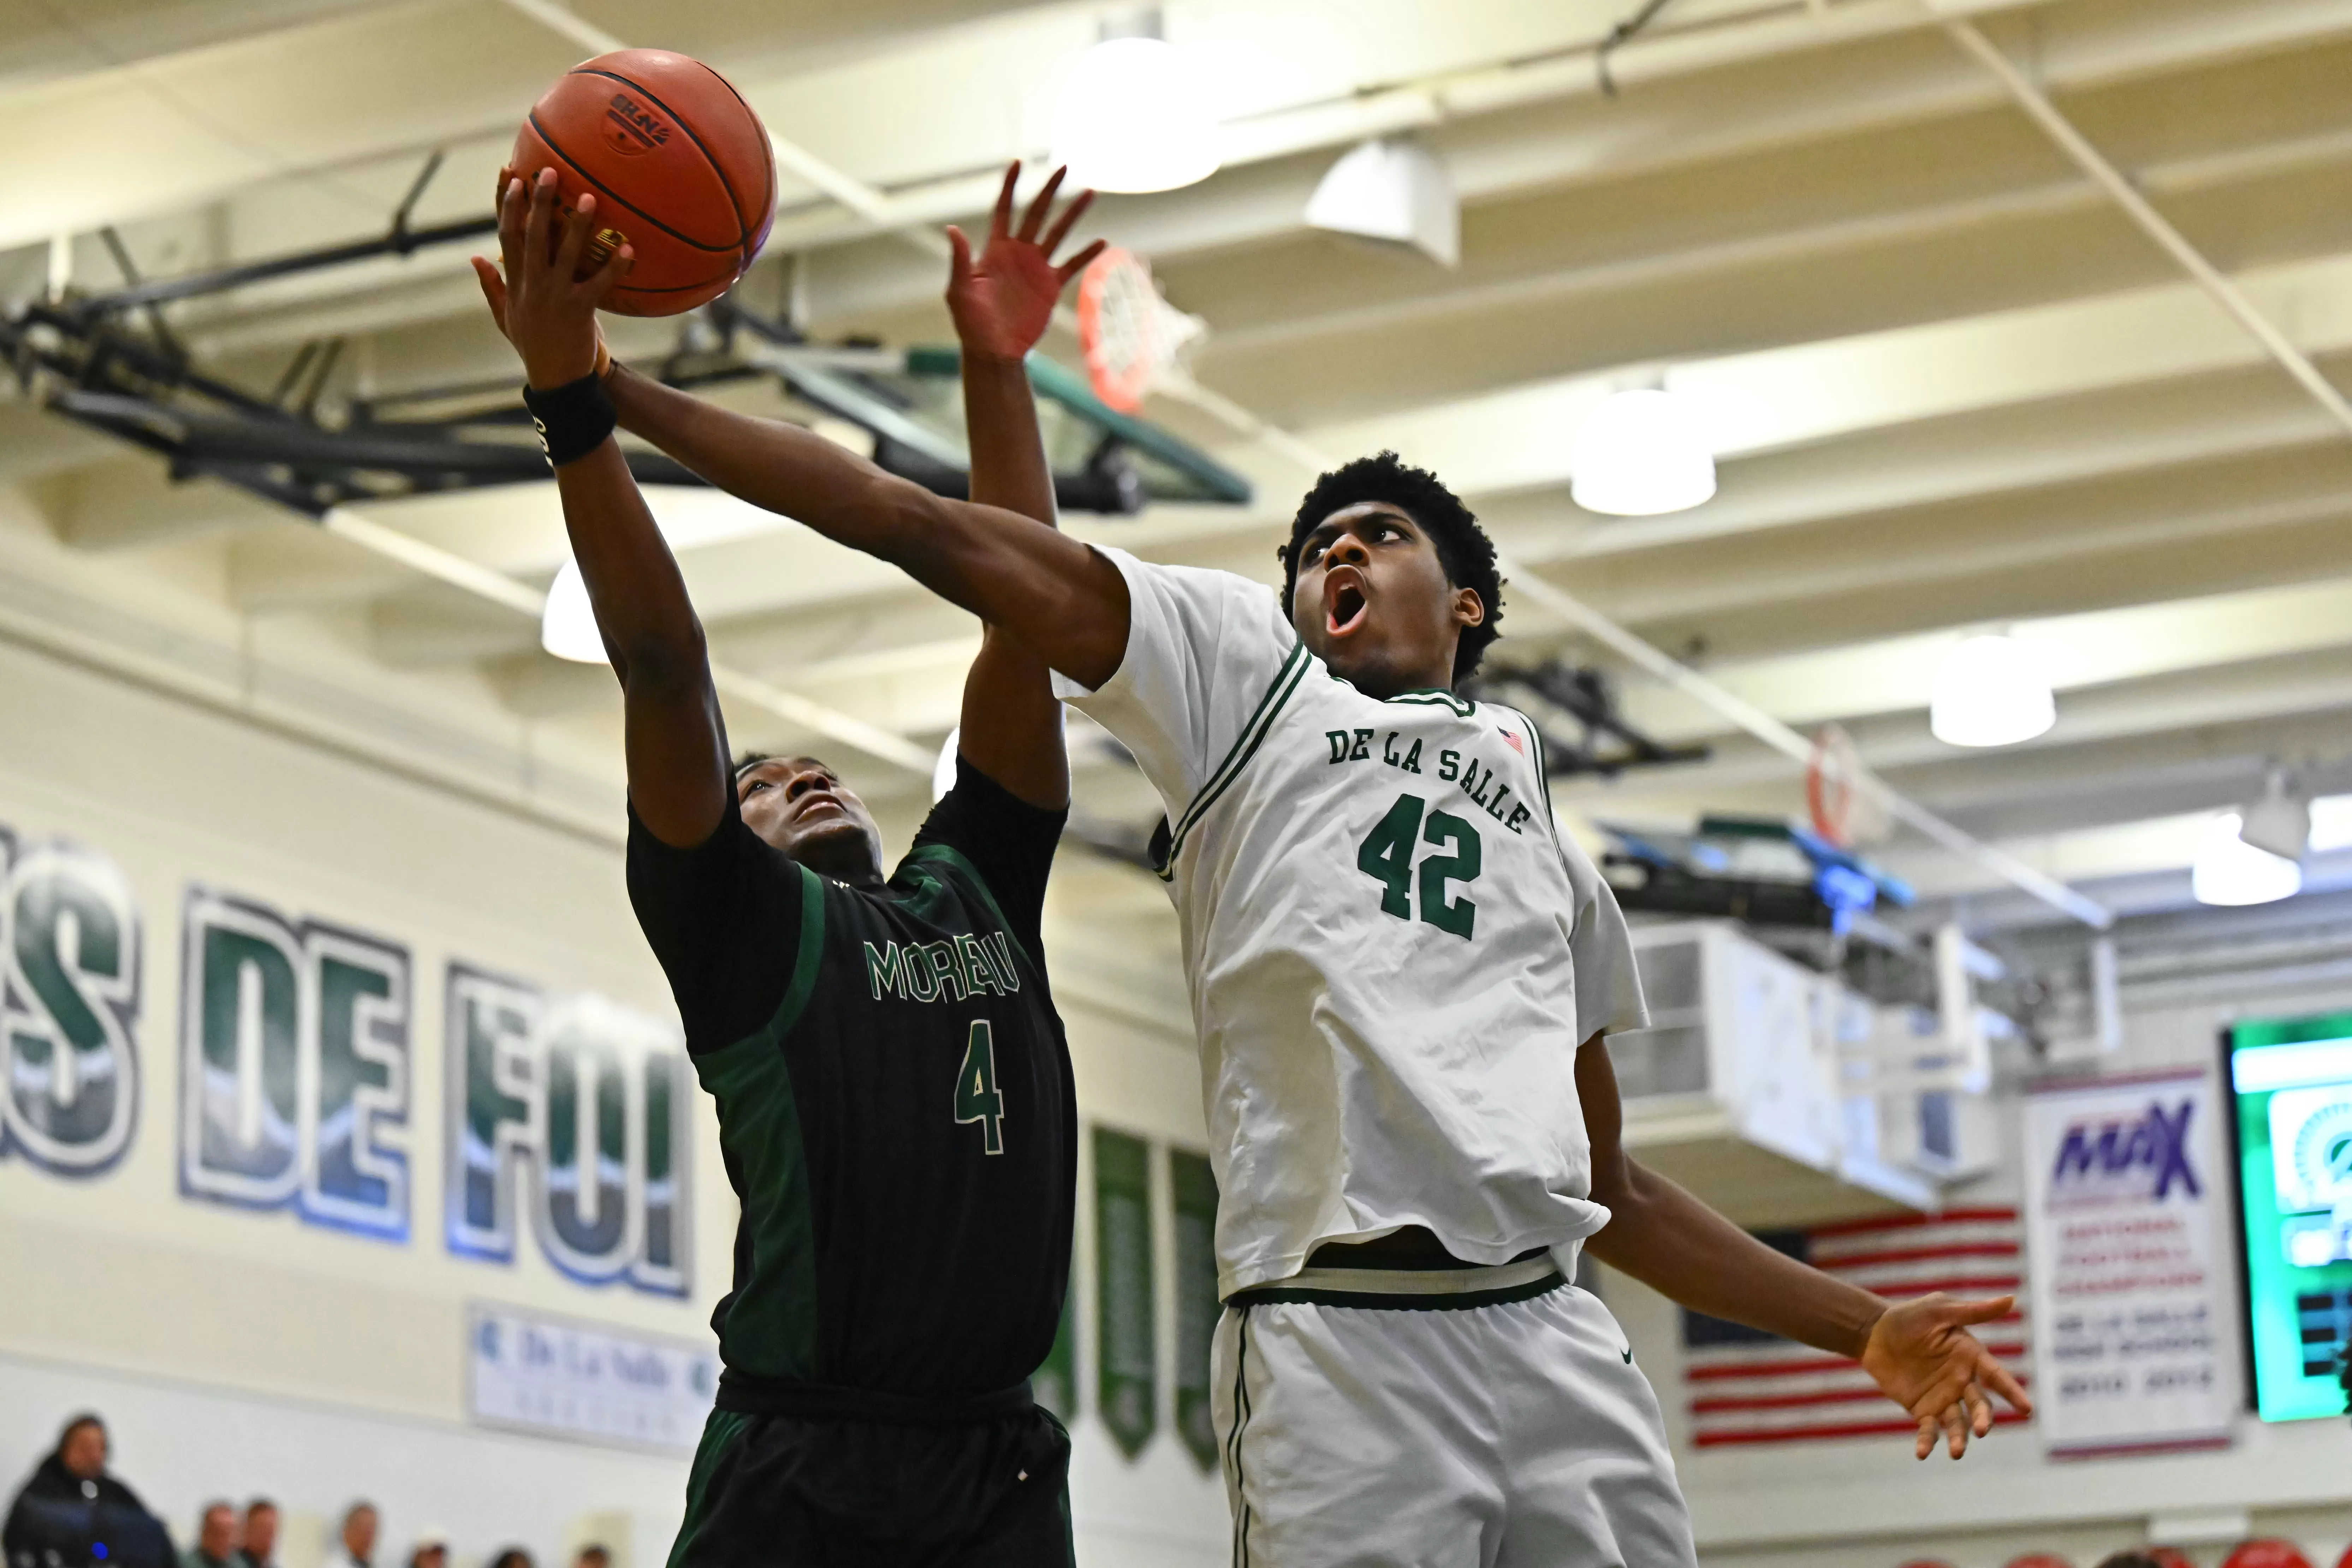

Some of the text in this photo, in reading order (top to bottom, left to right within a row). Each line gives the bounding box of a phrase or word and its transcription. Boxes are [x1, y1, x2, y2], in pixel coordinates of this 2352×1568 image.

[1325, 729, 1531, 835] DE LA SALLE
[1357, 793, 1481, 941] 42
[863, 931, 1020, 1004] MOREAU
[0, 842, 139, 1183] S
[178, 884, 412, 1245] DE
[954, 1019, 1004, 1156] 4
